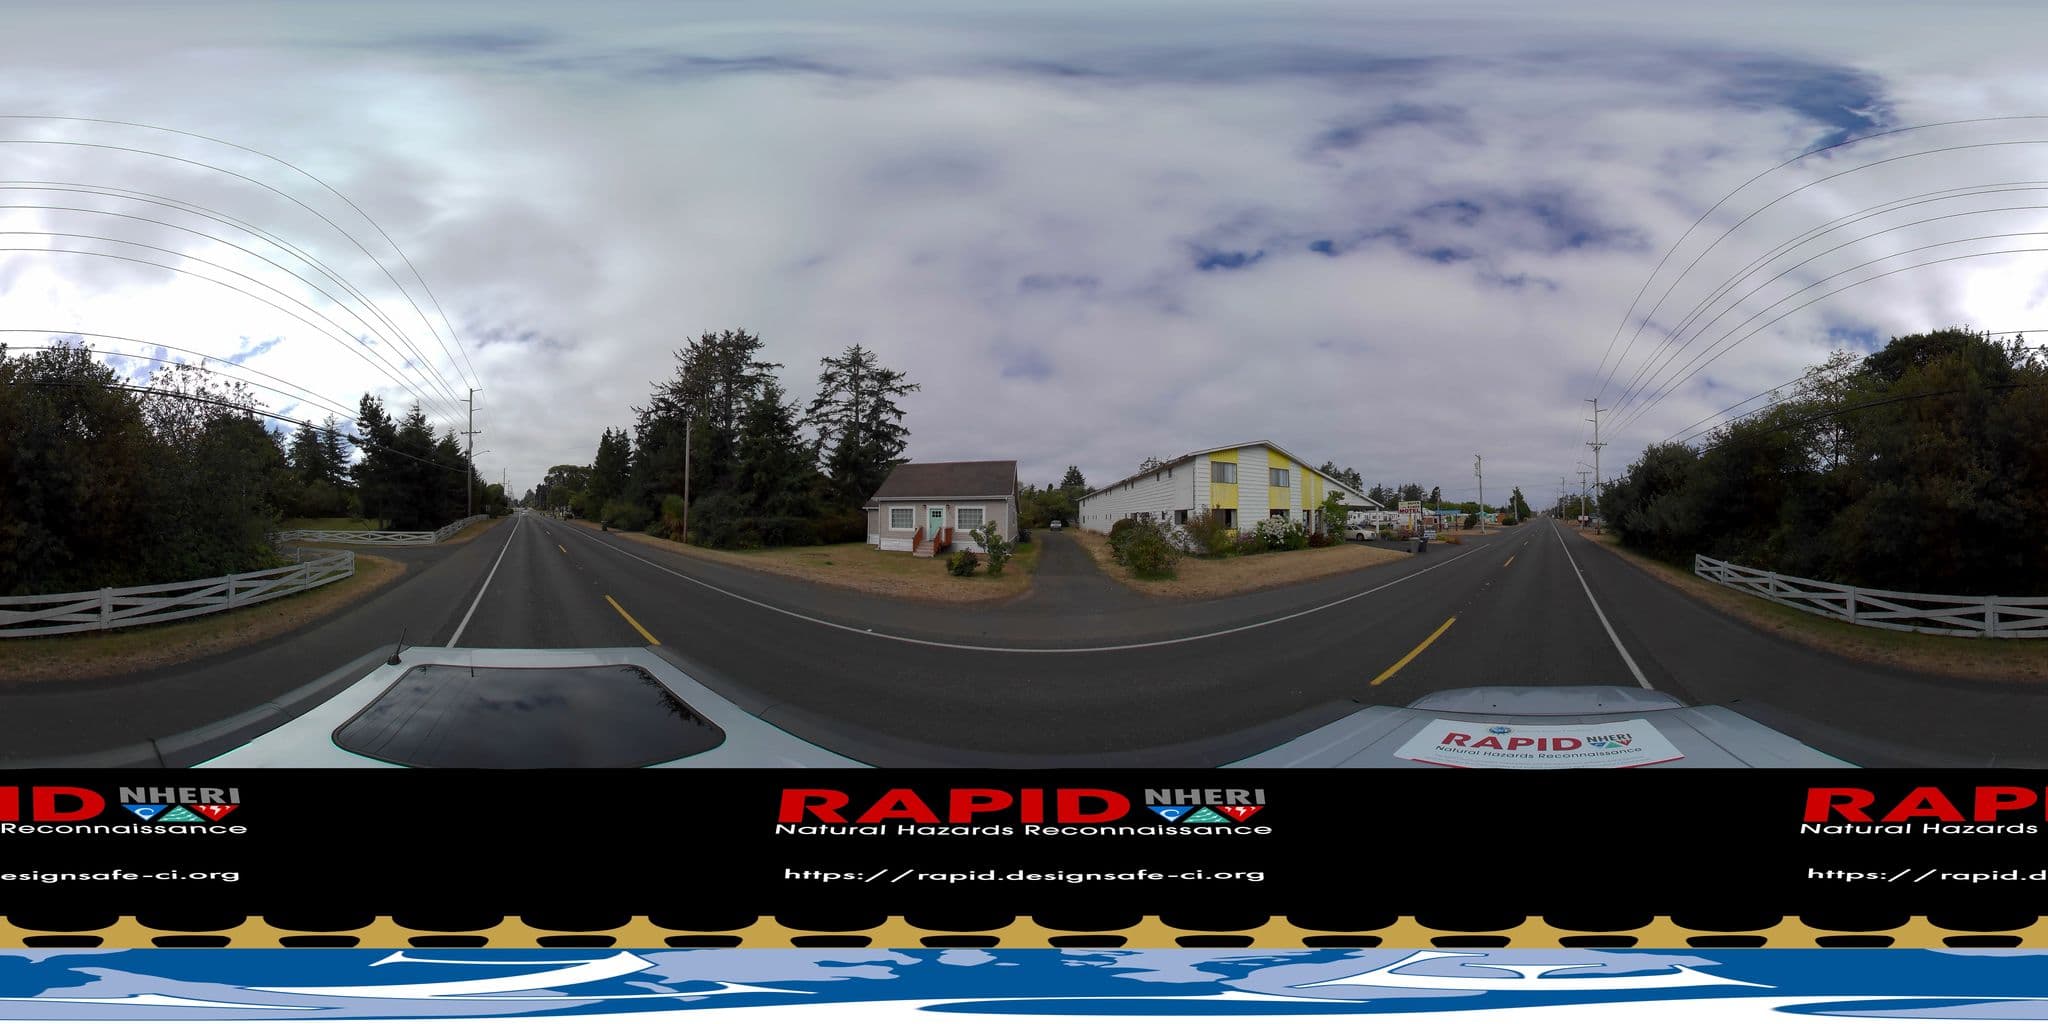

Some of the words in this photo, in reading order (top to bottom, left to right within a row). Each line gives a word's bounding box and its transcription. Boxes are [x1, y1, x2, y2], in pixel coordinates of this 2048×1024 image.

[1441, 732, 1582, 752] RAPID
[1586, 733, 1633, 743] NHERI
[1435, 745, 1480, 756] Natural
[1483, 750, 1534, 759] Hazards
[1538, 747, 1642, 759] Reconnaissance
